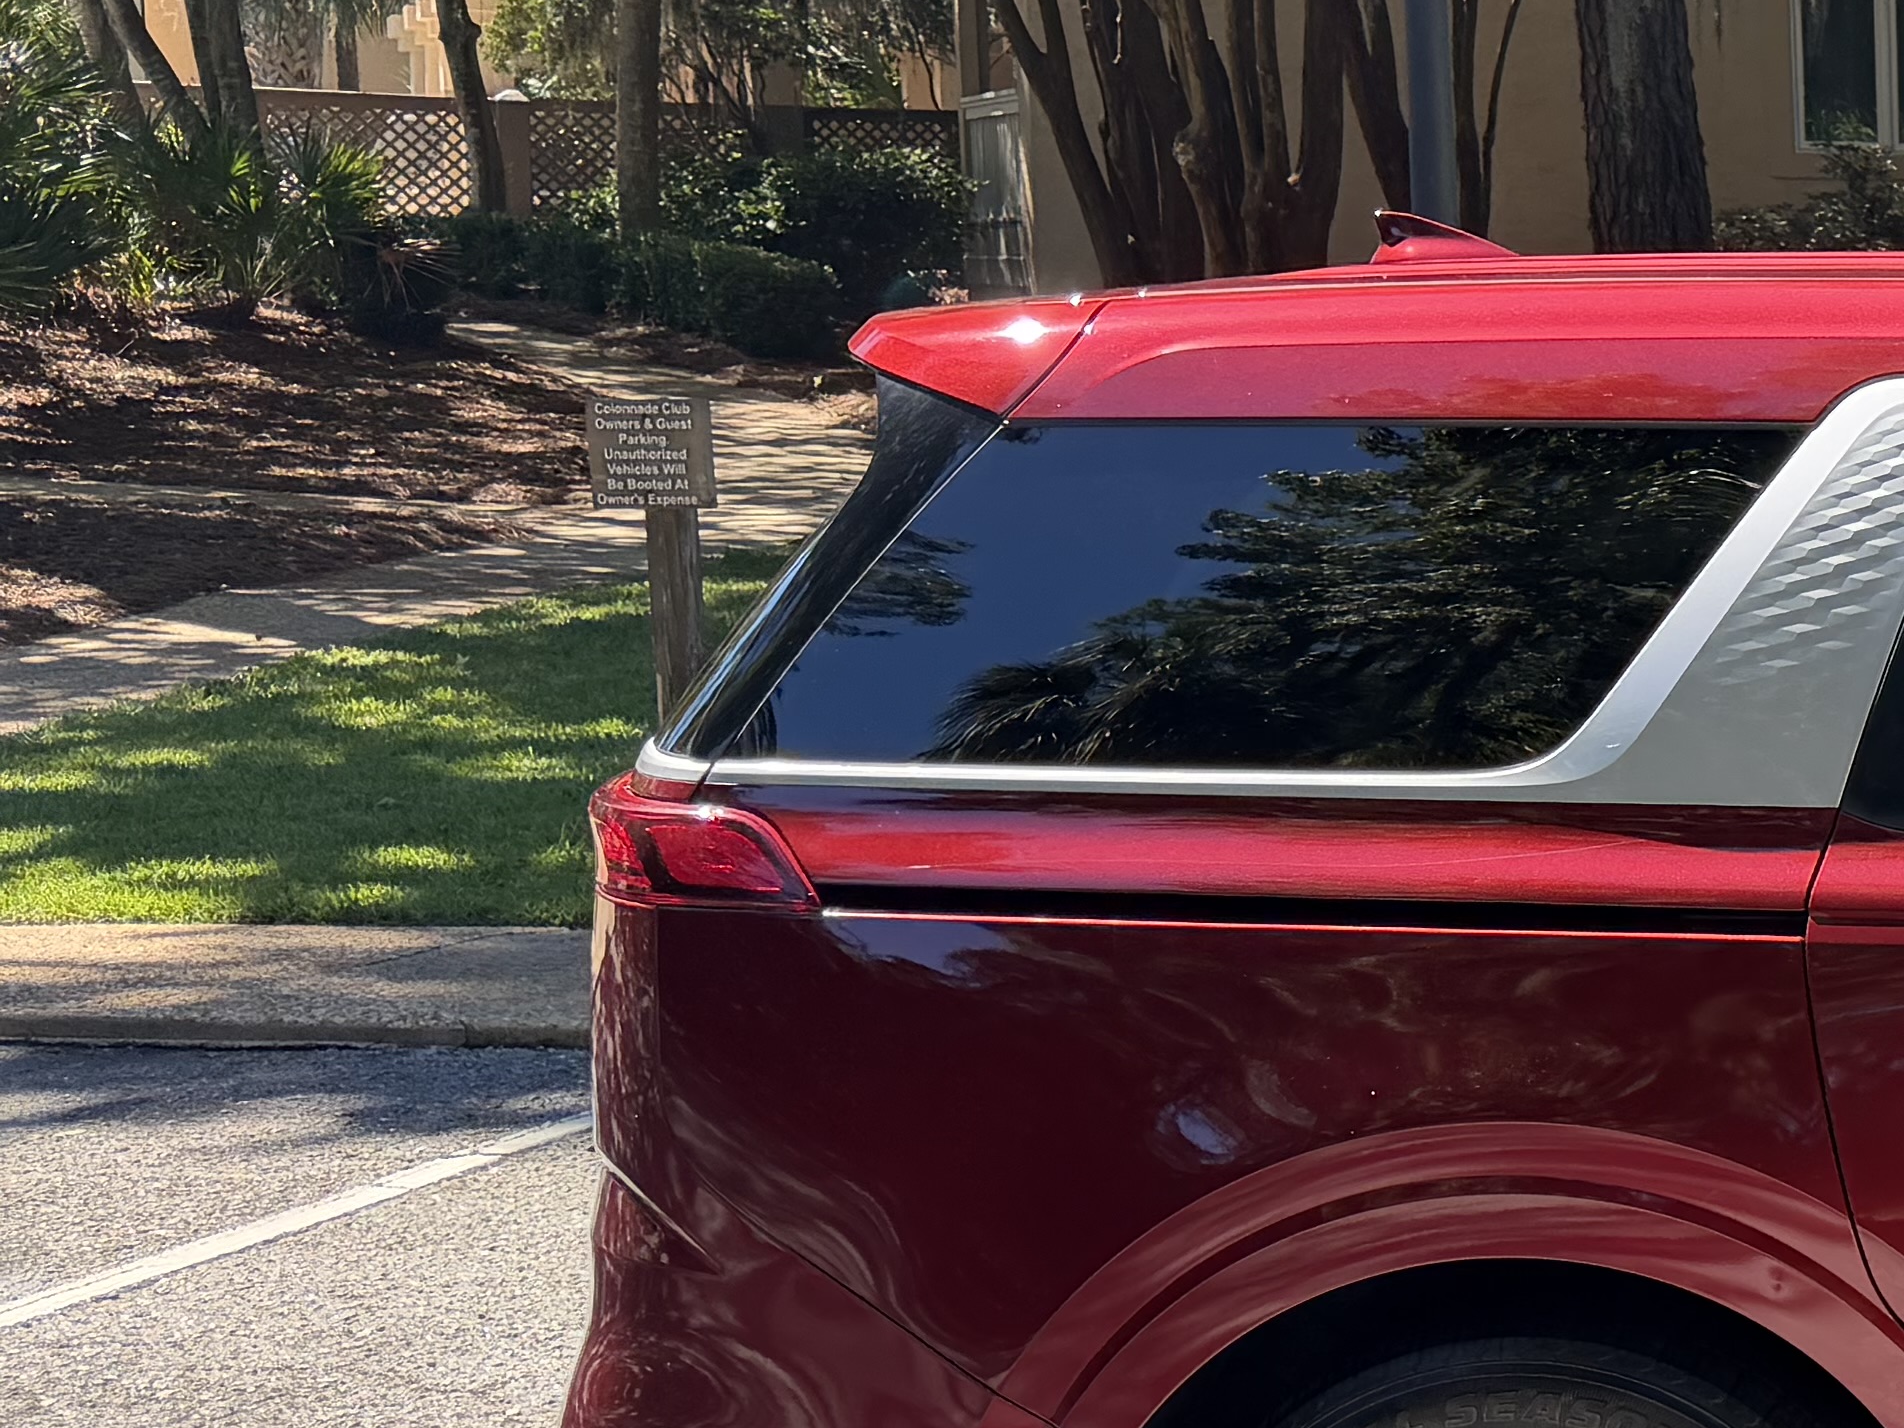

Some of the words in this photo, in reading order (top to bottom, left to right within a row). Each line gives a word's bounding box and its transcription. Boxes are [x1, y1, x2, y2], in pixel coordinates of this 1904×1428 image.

[594, 402, 659, 415] Colonnade
[661, 402, 691, 415] Club
[595, 418, 641, 430] Owners
[643, 418, 653, 430] &
[655, 418, 692, 430] Guest
[604, 448, 687, 460] Unauthorized
[607, 463, 659, 475] Vehicles
[662, 463, 687, 475] Will
[607, 479, 624, 490] Be
[627, 478, 672, 490] Booted
[674, 479, 689, 490] At
[597, 493, 645, 506] Owner's
